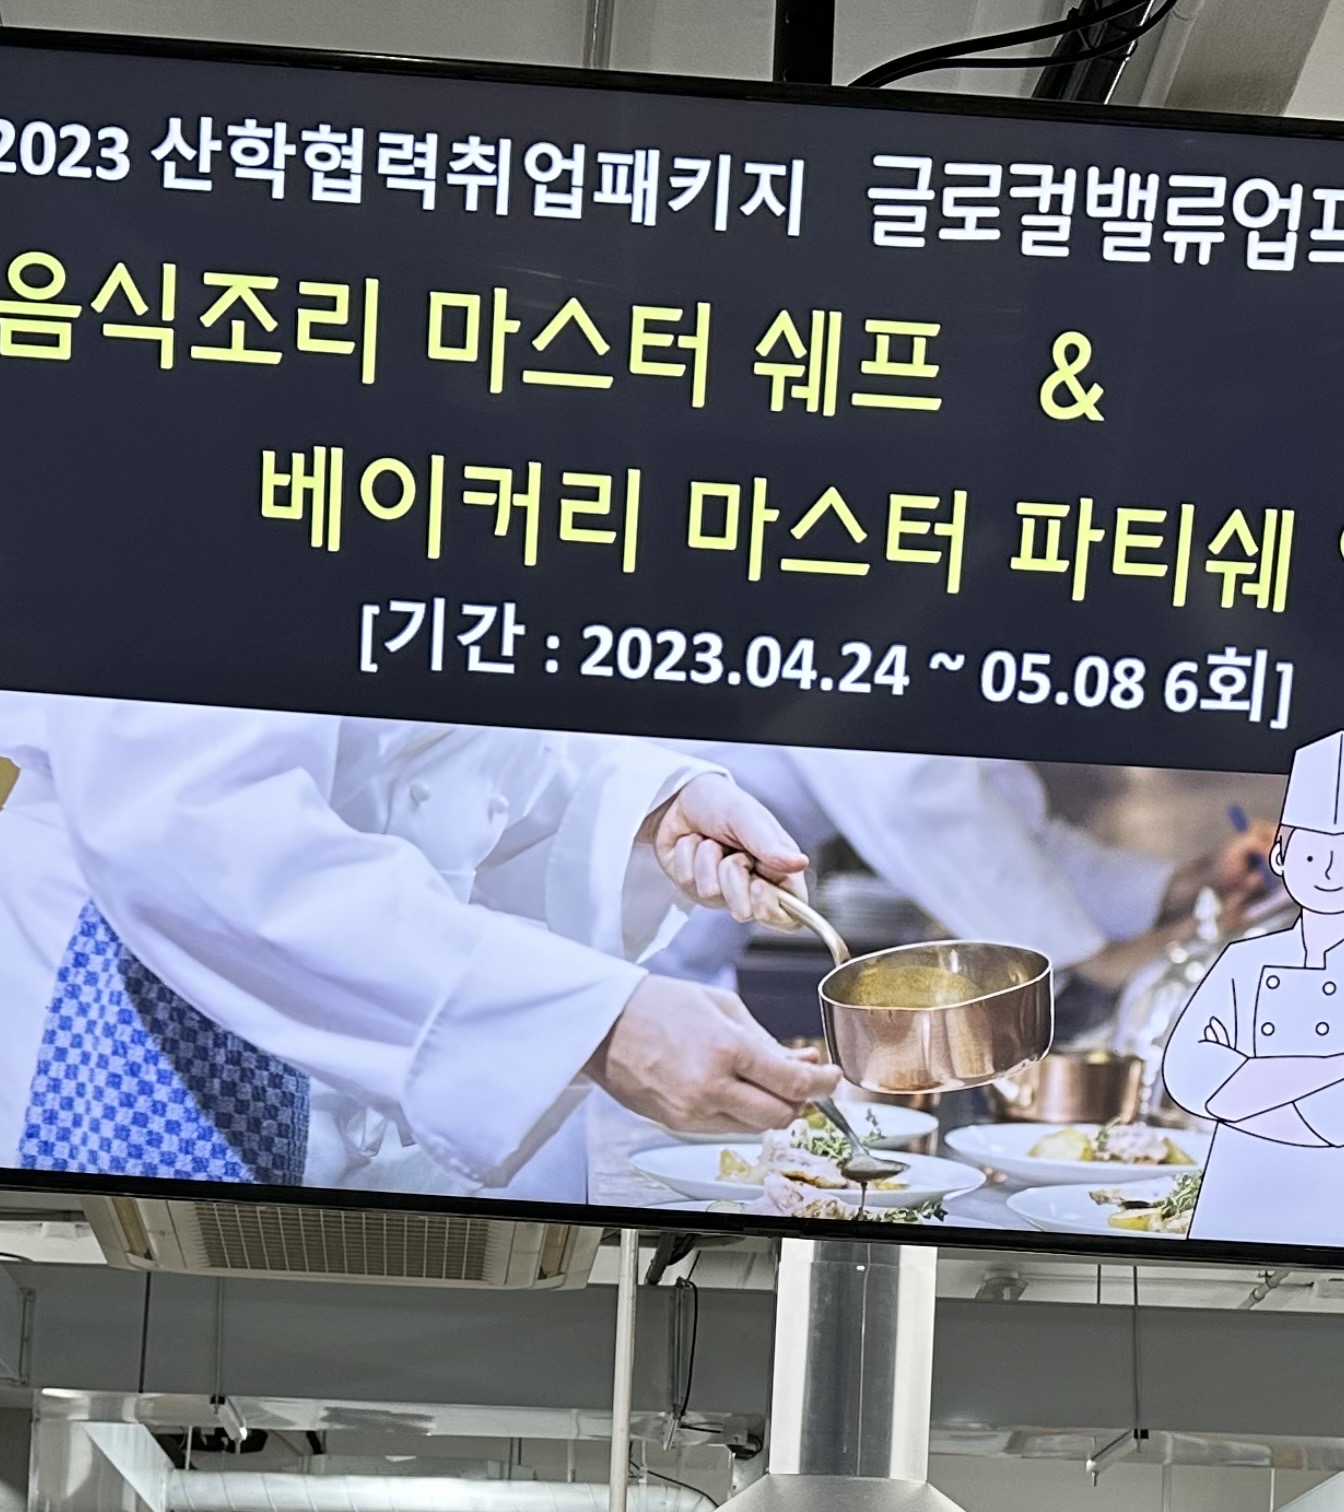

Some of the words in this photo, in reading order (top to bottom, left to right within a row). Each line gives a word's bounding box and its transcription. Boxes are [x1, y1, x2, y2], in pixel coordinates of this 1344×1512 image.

[150, 116, 805, 237] 산학협력취업패키지
[427, 287, 711, 409] 마스터
[753, 309, 943, 417] 쉐프
[1039, 331, 1106, 422] &
[261, 445, 641, 573] 베이커리
[687, 477, 968, 594] 마스터
[1010, 497, 1295, 613] 파티쉐
[360, 597, 526, 674] [기간
[580, 624, 910, 696] 2023.04.24
[981, 650, 1146, 710] 05.08
[1164, 646, 1294, 730] 6회]
